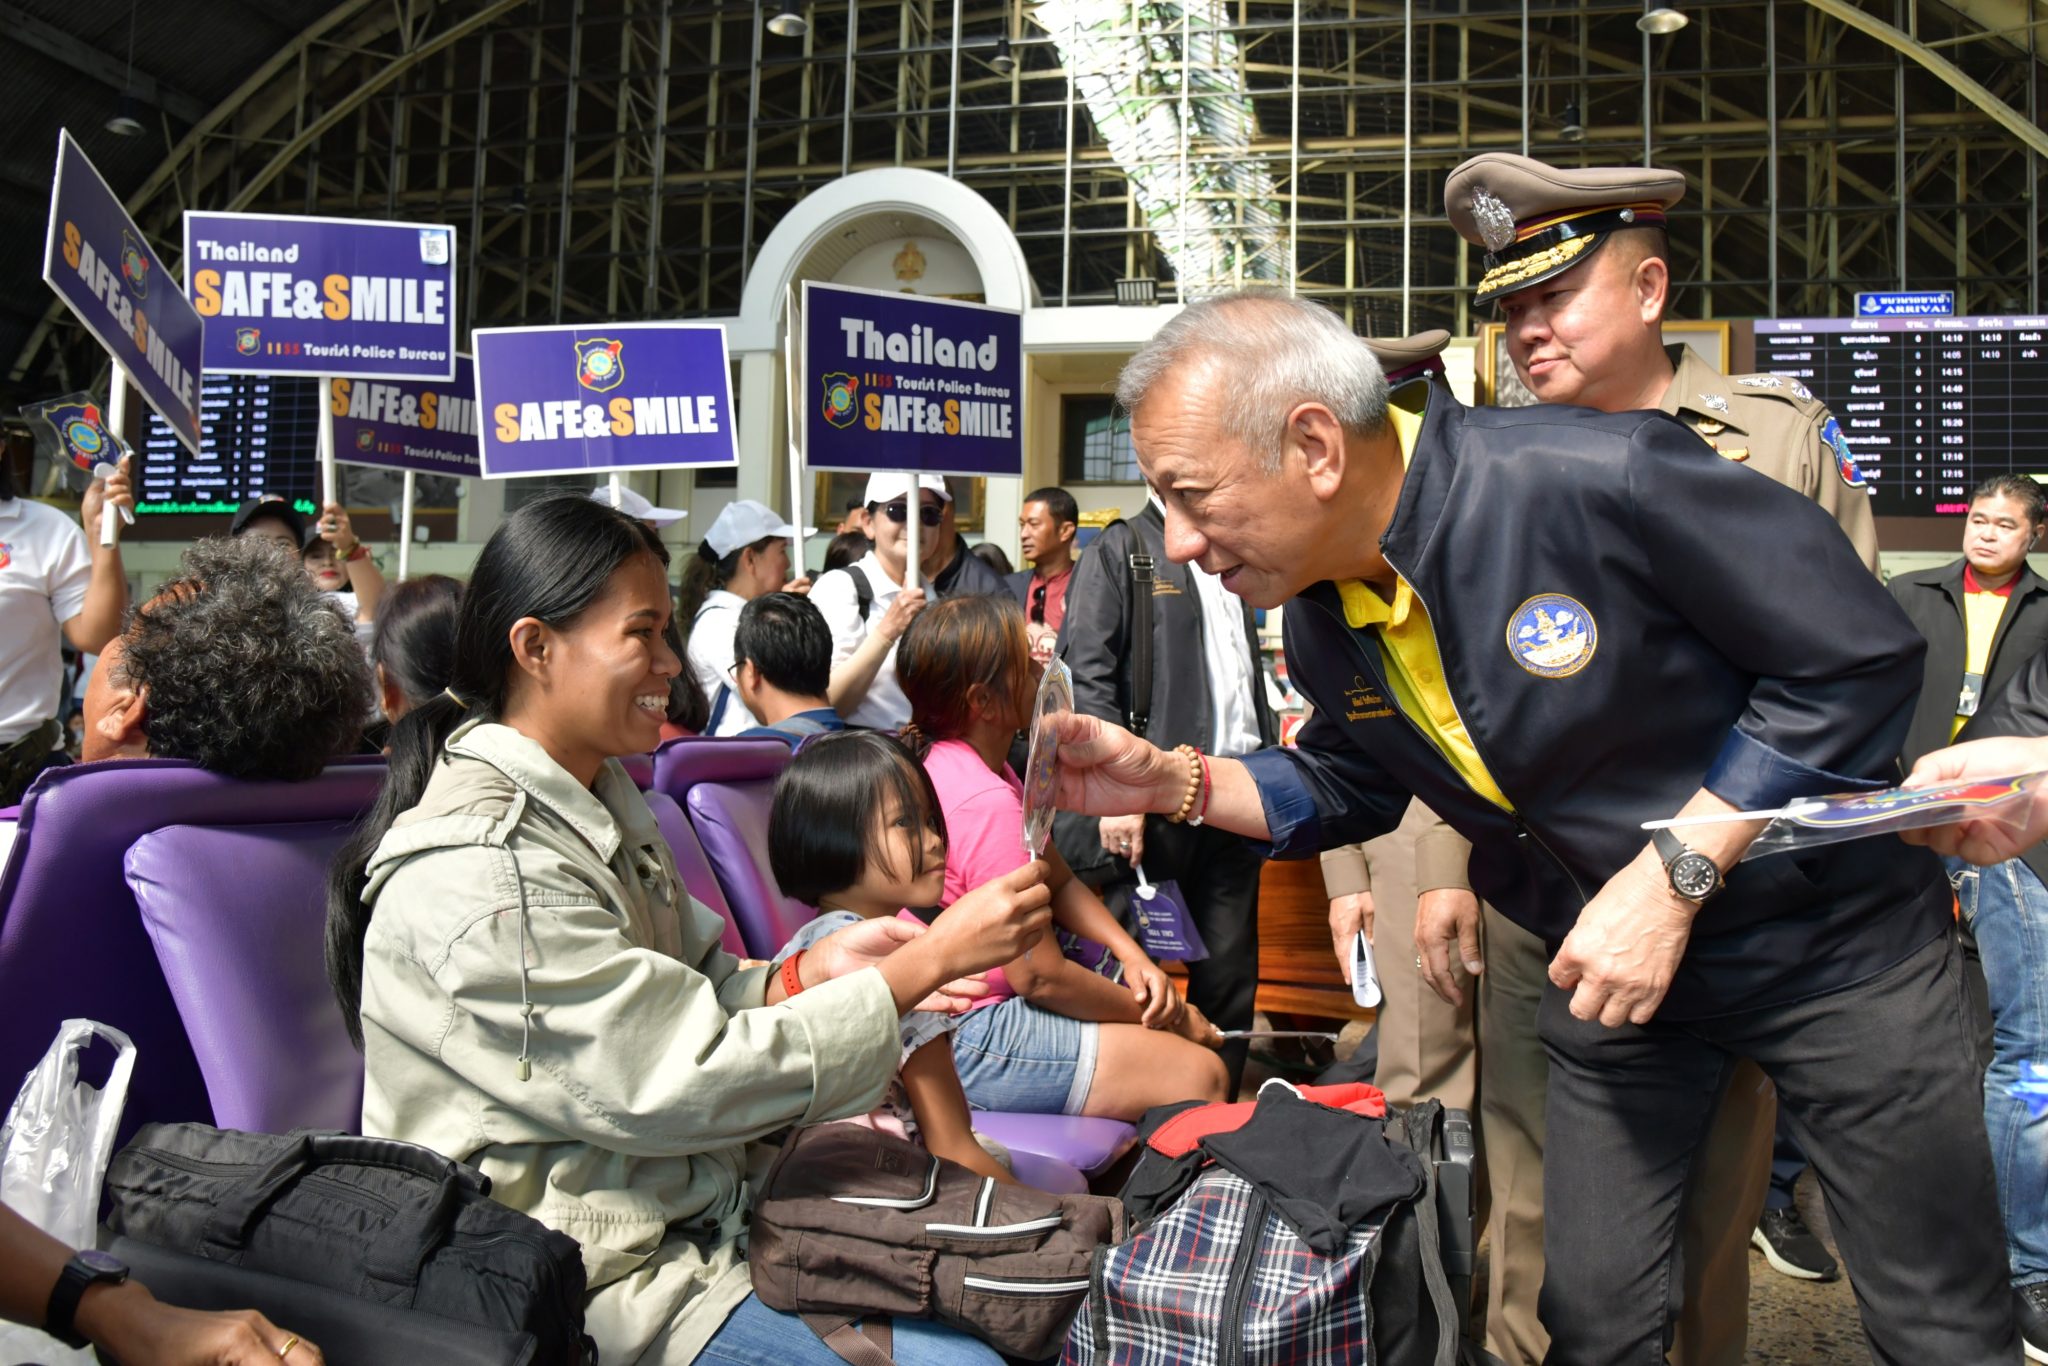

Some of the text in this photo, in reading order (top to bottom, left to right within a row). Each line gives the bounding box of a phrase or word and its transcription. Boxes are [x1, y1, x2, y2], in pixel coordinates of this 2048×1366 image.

[197, 240, 299, 264] Thailand
[194, 268, 446, 325] SAFE&SMILE
[62, 221, 193, 408] SAFE&SMILE
[1885, 305, 1950, 314] ARRIVAL
[840, 317, 998, 372] Thailand
[1942, 334, 1963, 343] 14:10
[1980, 333, 2002, 342] 14:10
[267, 341, 446, 361] 1155 Tourist Police Bureau
[1942, 351, 1962, 360] 14:05
[1981, 350, 2001, 359] 14:10
[1942, 368, 1963, 377] 14:15
[895, 375, 936, 392] Tourist
[937, 379, 973, 396] Police
[974, 382, 1011, 399] Bureau
[1942, 385, 1963, 394] 14:40
[331, 378, 478, 436] SAFE&SMIL
[864, 392, 1013, 439] SAFE&SMILE
[493, 396, 719, 444] SAFE&SMILE
